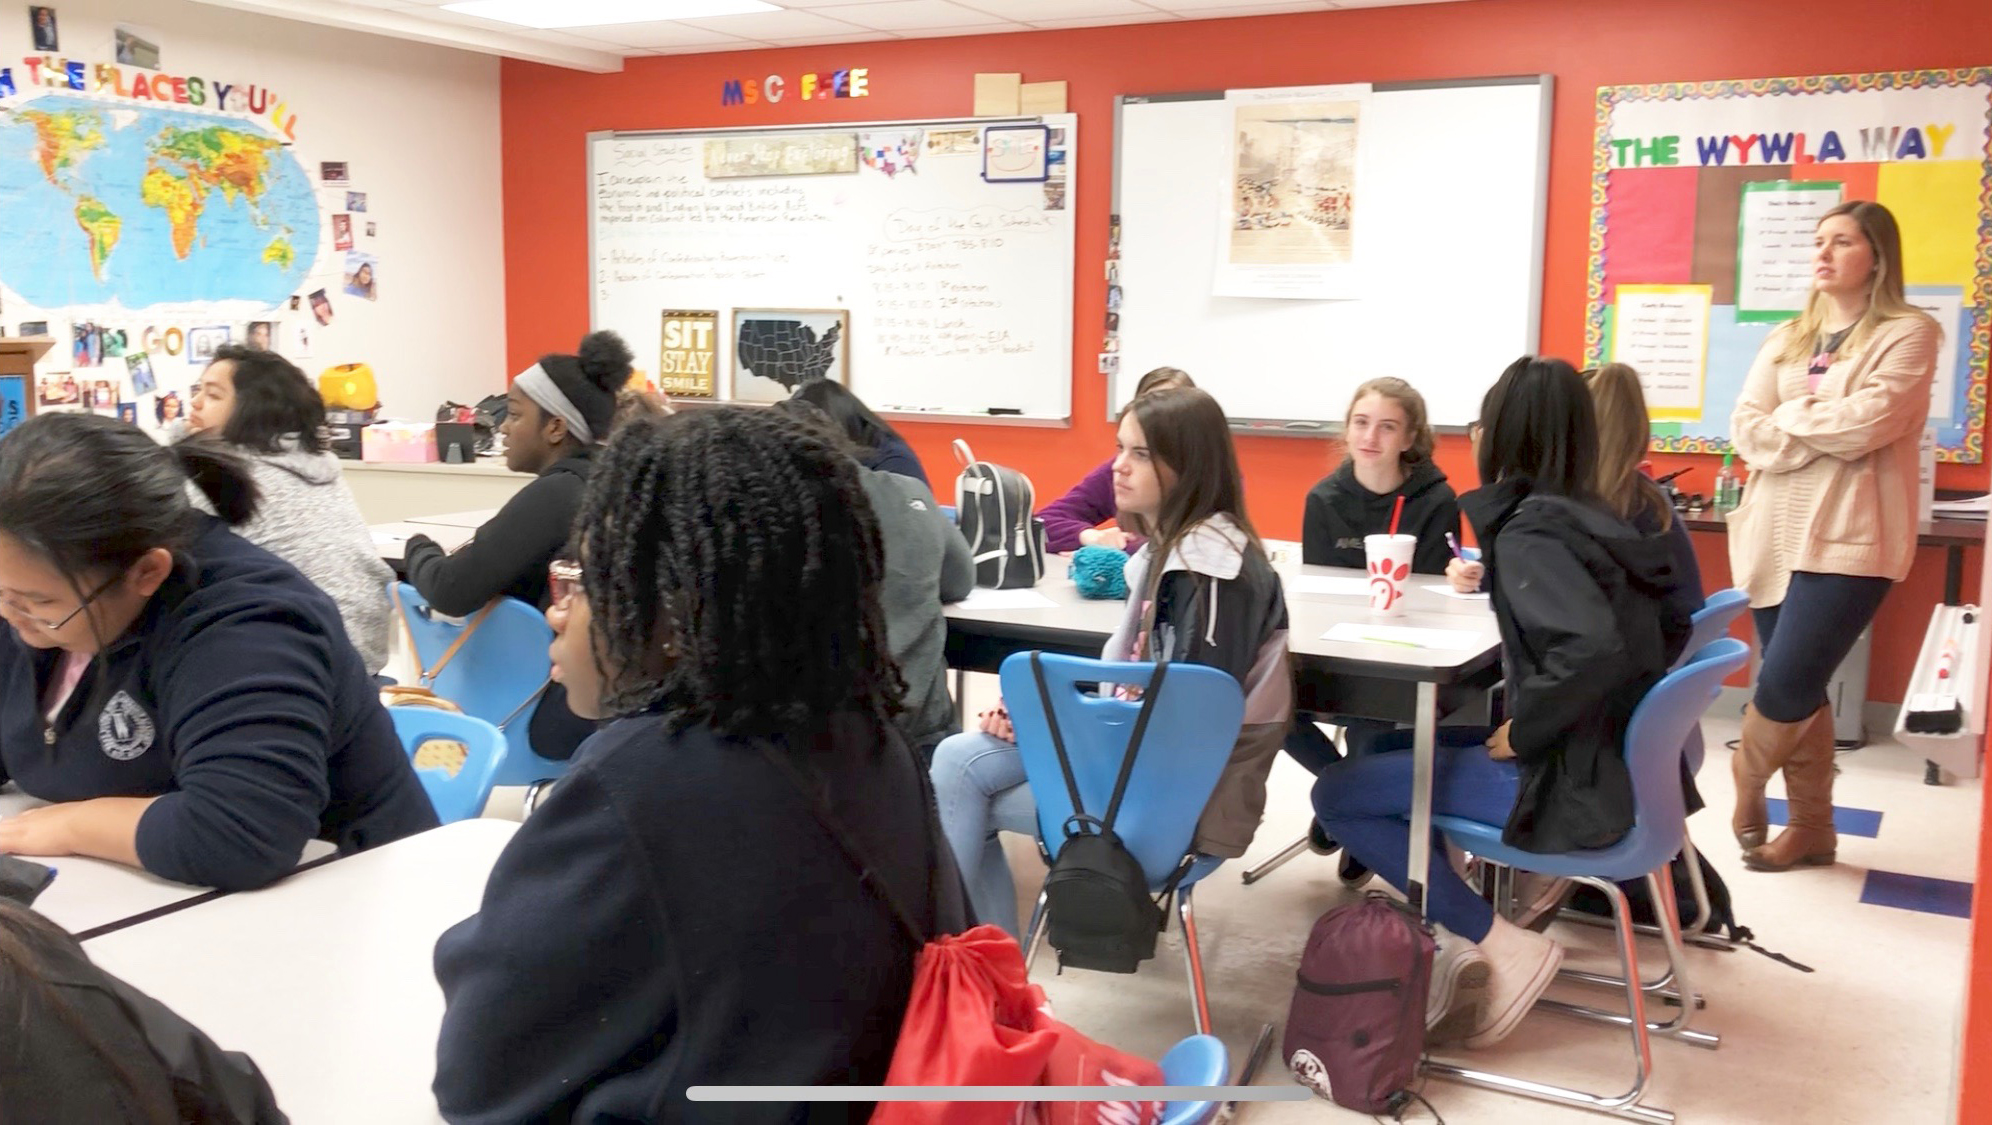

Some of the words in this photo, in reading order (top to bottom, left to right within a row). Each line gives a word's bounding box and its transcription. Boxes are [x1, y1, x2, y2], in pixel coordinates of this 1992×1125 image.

[23, 56, 86, 90] THE
[95, 63, 206, 106] PLACES
[213, 81, 298, 141] YOU'LL
[763, 67, 870, 104] CFFEE
[1611, 134, 1680, 167] THE
[1697, 130, 1847, 167] WYWLA
[1860, 122, 1956, 163] WAY
[142, 325, 185, 357] GO
[664, 319, 714, 350] SIT
[662, 350, 713, 375] STAY
[662, 376, 708, 391] SMILE
